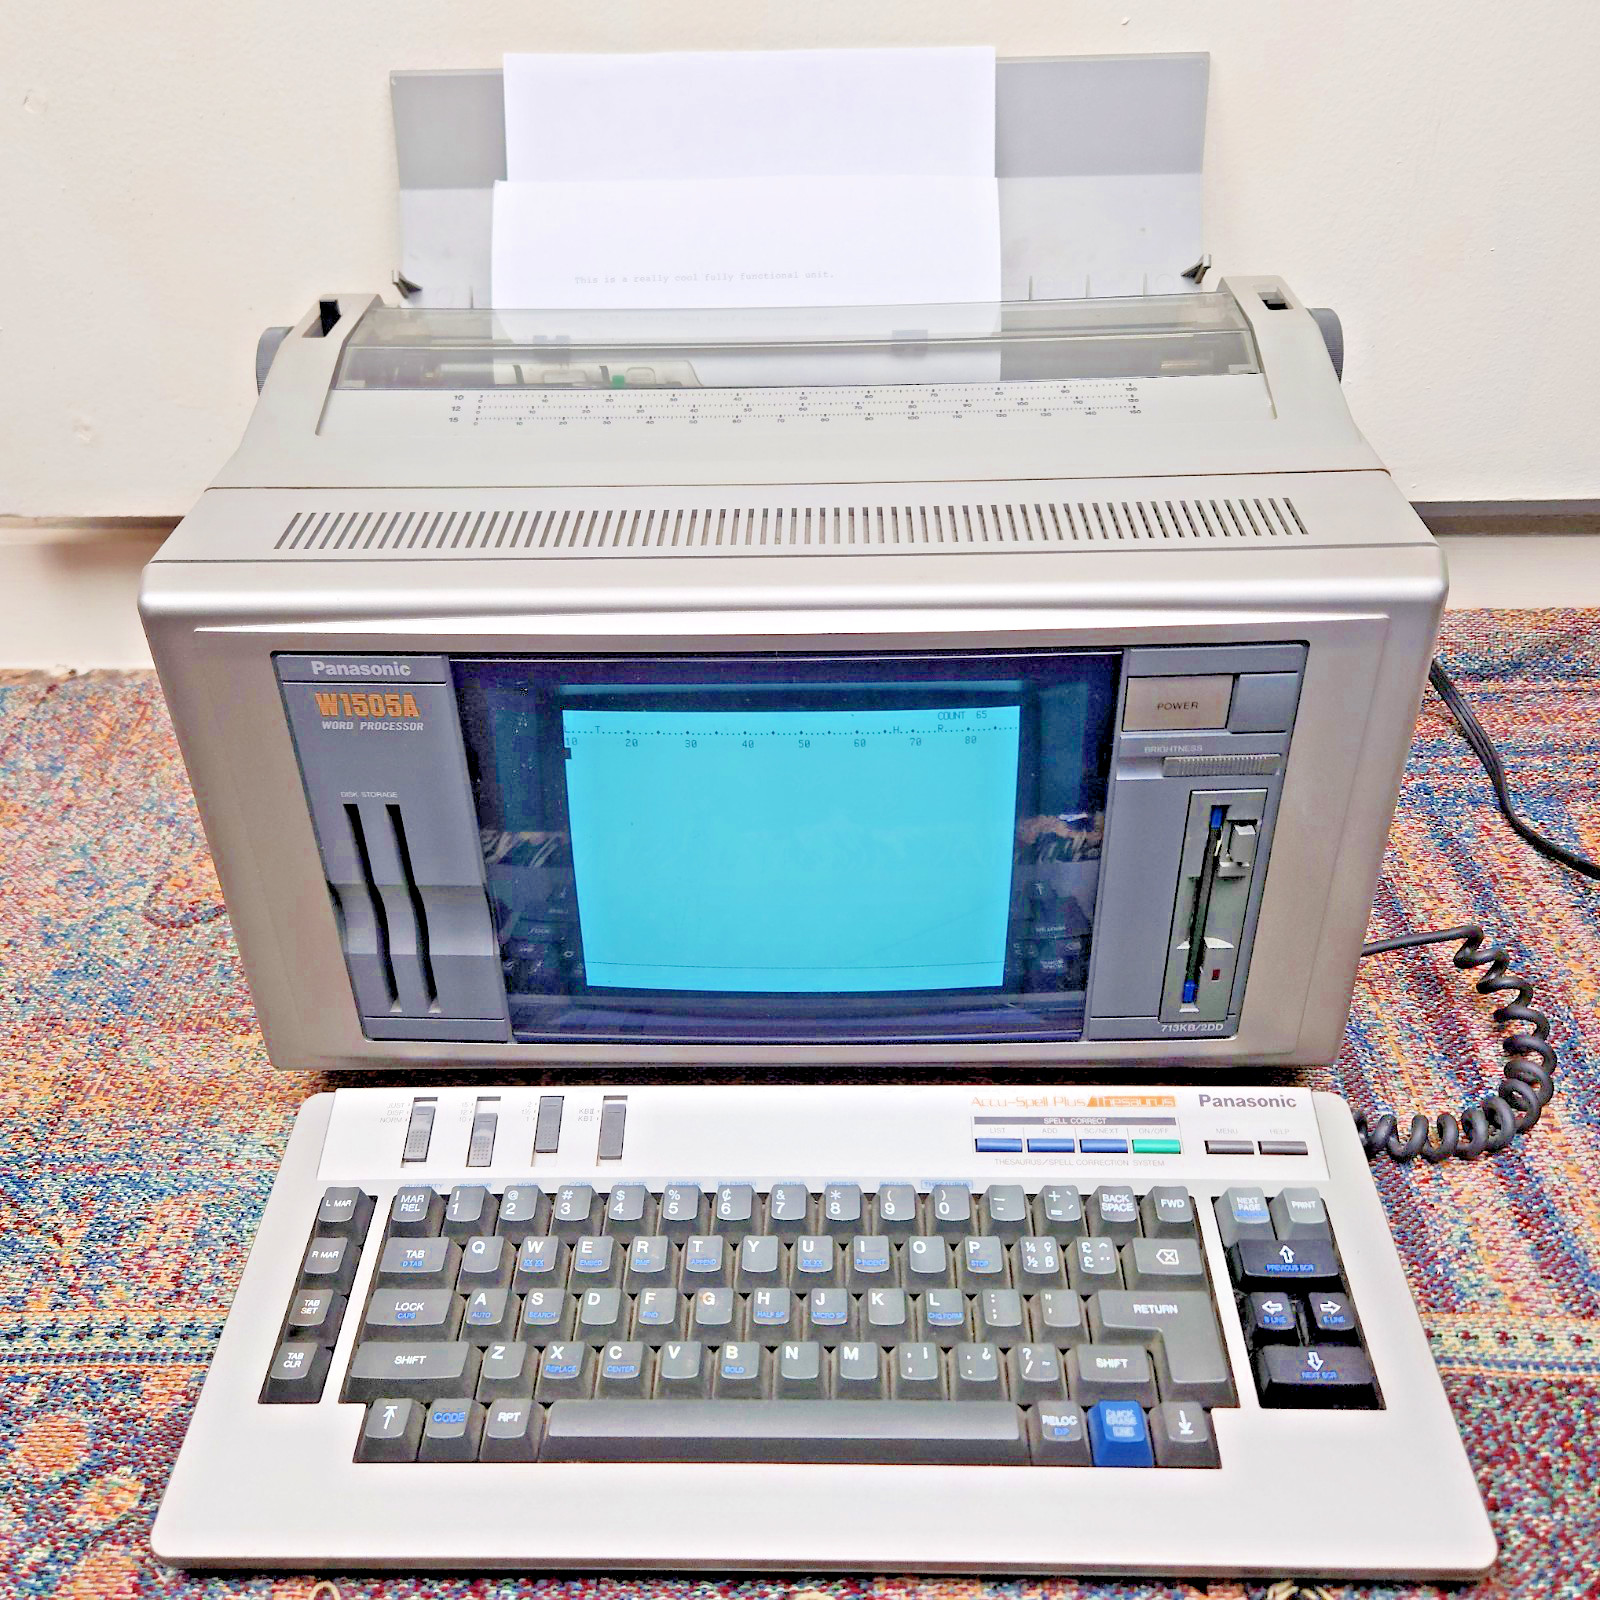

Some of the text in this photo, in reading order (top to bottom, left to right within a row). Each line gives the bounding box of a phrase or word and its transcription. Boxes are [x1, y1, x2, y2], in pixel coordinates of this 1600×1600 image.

[574, 275, 598, 285] This
[604, 275, 616, 284] is
[634, 274, 668, 285] really
[674, 273, 698, 283] cool
[704, 273, 734, 283] fully
[740, 271, 799, 282] functional
[805, 270, 835, 280] unit.
[310, 660, 412, 677] Panasonic
[314, 692, 421, 718] W1505A
[1157, 701, 1199, 711] POWER
[937, 710, 988, 721] COUNT 65
[321, 720, 424, 731] WORD PROCESSOR
[565, 735, 977, 749] 10 20 30 40 50 60 70 80
[1144, 744, 1203, 754] BRIGHTNESS
[1161, 1023, 1224, 1033] 713KB/2DD
[970, 1095, 1175, 1109] Accu-Spell Plus Thesaurus
[1198, 1093, 1297, 1108] Panasonic
[1043, 1117, 1107, 1125] SPELL CORRECT
[994, 1158, 1165, 1167] THESAURUS/SPELL CORRECTION SYSTEM
[333, 1200, 352, 1208] MAR
[400, 1194, 425, 1203] MAR
[1102, 1193, 1129, 1203] BACK
[1160, 1199, 1185, 1209] FWD
[1237, 1196, 1260, 1204] NEXT
[400, 1203, 421, 1212] REL
[452, 1203, 460, 1215] 1
[505, 1203, 517, 1215] 2
[560, 1203, 571, 1215] 3
[613, 1202, 624, 1214] 4
[668, 1202, 679, 1215] 5
[720, 1202, 731, 1215] 6
[775, 1202, 786, 1214] 7
[830, 1202, 841, 1215] 8
[884, 1202, 896, 1215] 9
[938, 1202, 950, 1215] 0
[1101, 1202, 1134, 1213] SPACE
[1238, 1203, 1261, 1212] PAGE
[1291, 1200, 1316, 1209] PRINT
[471, 1241, 486, 1254] Q
[527, 1241, 544, 1253] W
[581, 1241, 593, 1254] E
[637, 1240, 649, 1253] R
[692, 1240, 704, 1253] T
[748, 1240, 760, 1253] Y
[802, 1240, 814, 1253] U
[912, 1240, 927, 1254] O
[968, 1241, 981, 1254] P
[320, 1251, 340, 1259] MAR
[406, 1250, 426, 1258] TAB
[691, 1258, 717, 1266] APPEND
[304, 1299, 321, 1307] TAB
[474, 1293, 487, 1306] A
[531, 1292, 544, 1306] S
[588, 1293, 600, 1305] D
[645, 1292, 656, 1305] F
[702, 1292, 716, 1306] G
[757, 1292, 770, 1305] H
[815, 1292, 825, 1306] J
[871, 1293, 885, 1306] K
[929, 1293, 940, 1306] L
[300, 1307, 318, 1315] SET
[394, 1302, 425, 1311] LOCK
[1133, 1304, 1178, 1314] RETURN
[287, 1352, 305, 1360] TAB
[491, 1346, 506, 1359] Z
[550, 1346, 565, 1360] X
[609, 1346, 622, 1359] C
[668, 1345, 681, 1359] V
[726, 1345, 738, 1359] B
[785, 1346, 799, 1360] N
[843, 1346, 859, 1360] M
[283, 1360, 302, 1368] CLR
[394, 1355, 427, 1365] SHIFT
[1095, 1358, 1129, 1369] SHIFT
[545, 1365, 577, 1373] REPLACE
[607, 1365, 635, 1373] CENTER
[725, 1366, 744, 1374] BOLD
[432, 1411, 465, 1424] CODE
[497, 1412, 521, 1422] RPT
[1042, 1415, 1077, 1426] RELOC
